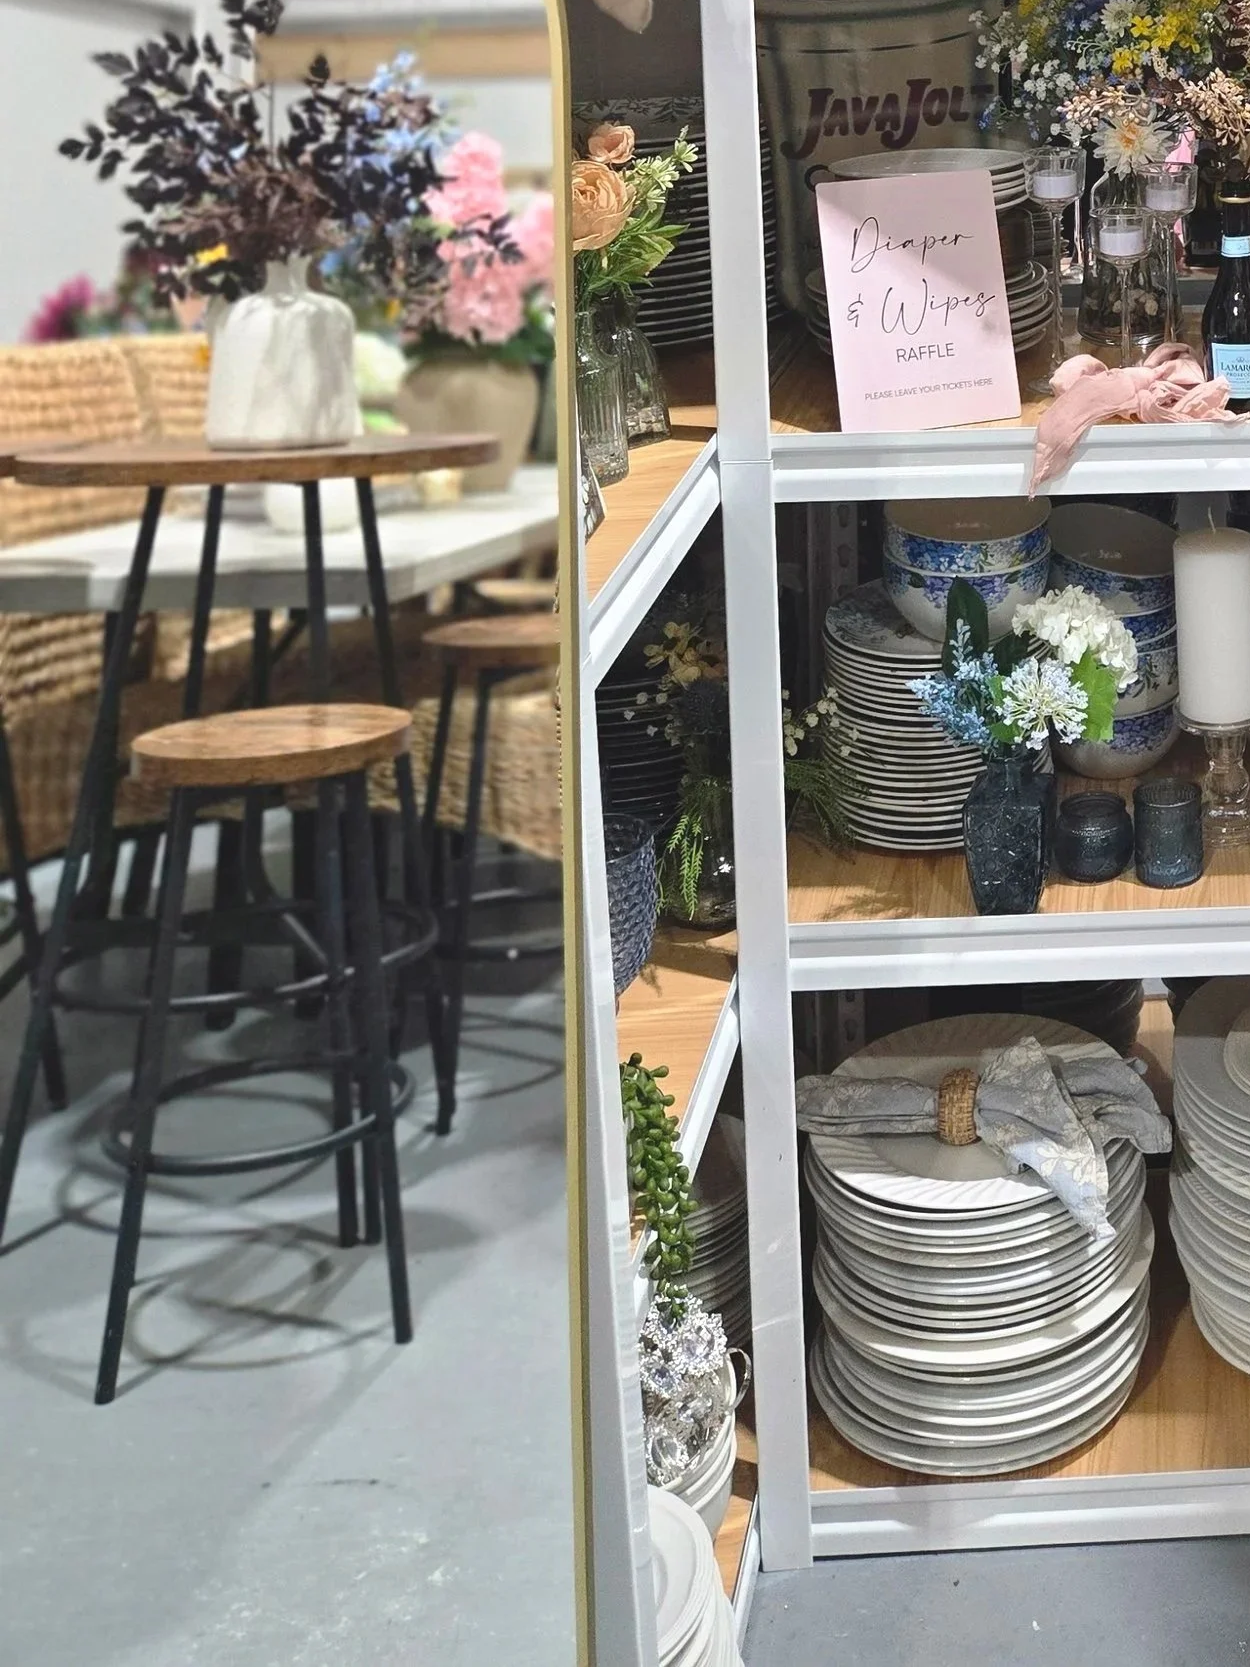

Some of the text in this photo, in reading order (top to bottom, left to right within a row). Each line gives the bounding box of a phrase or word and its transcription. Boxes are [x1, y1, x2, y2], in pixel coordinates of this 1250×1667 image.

[851, 216, 974, 273] Diaper
[846, 278, 996, 335] & Wipes
[896, 343, 955, 363] RAFFLE
[865, 377, 993, 401] PLEASE LEAVE YOUR TICKETS HERE
